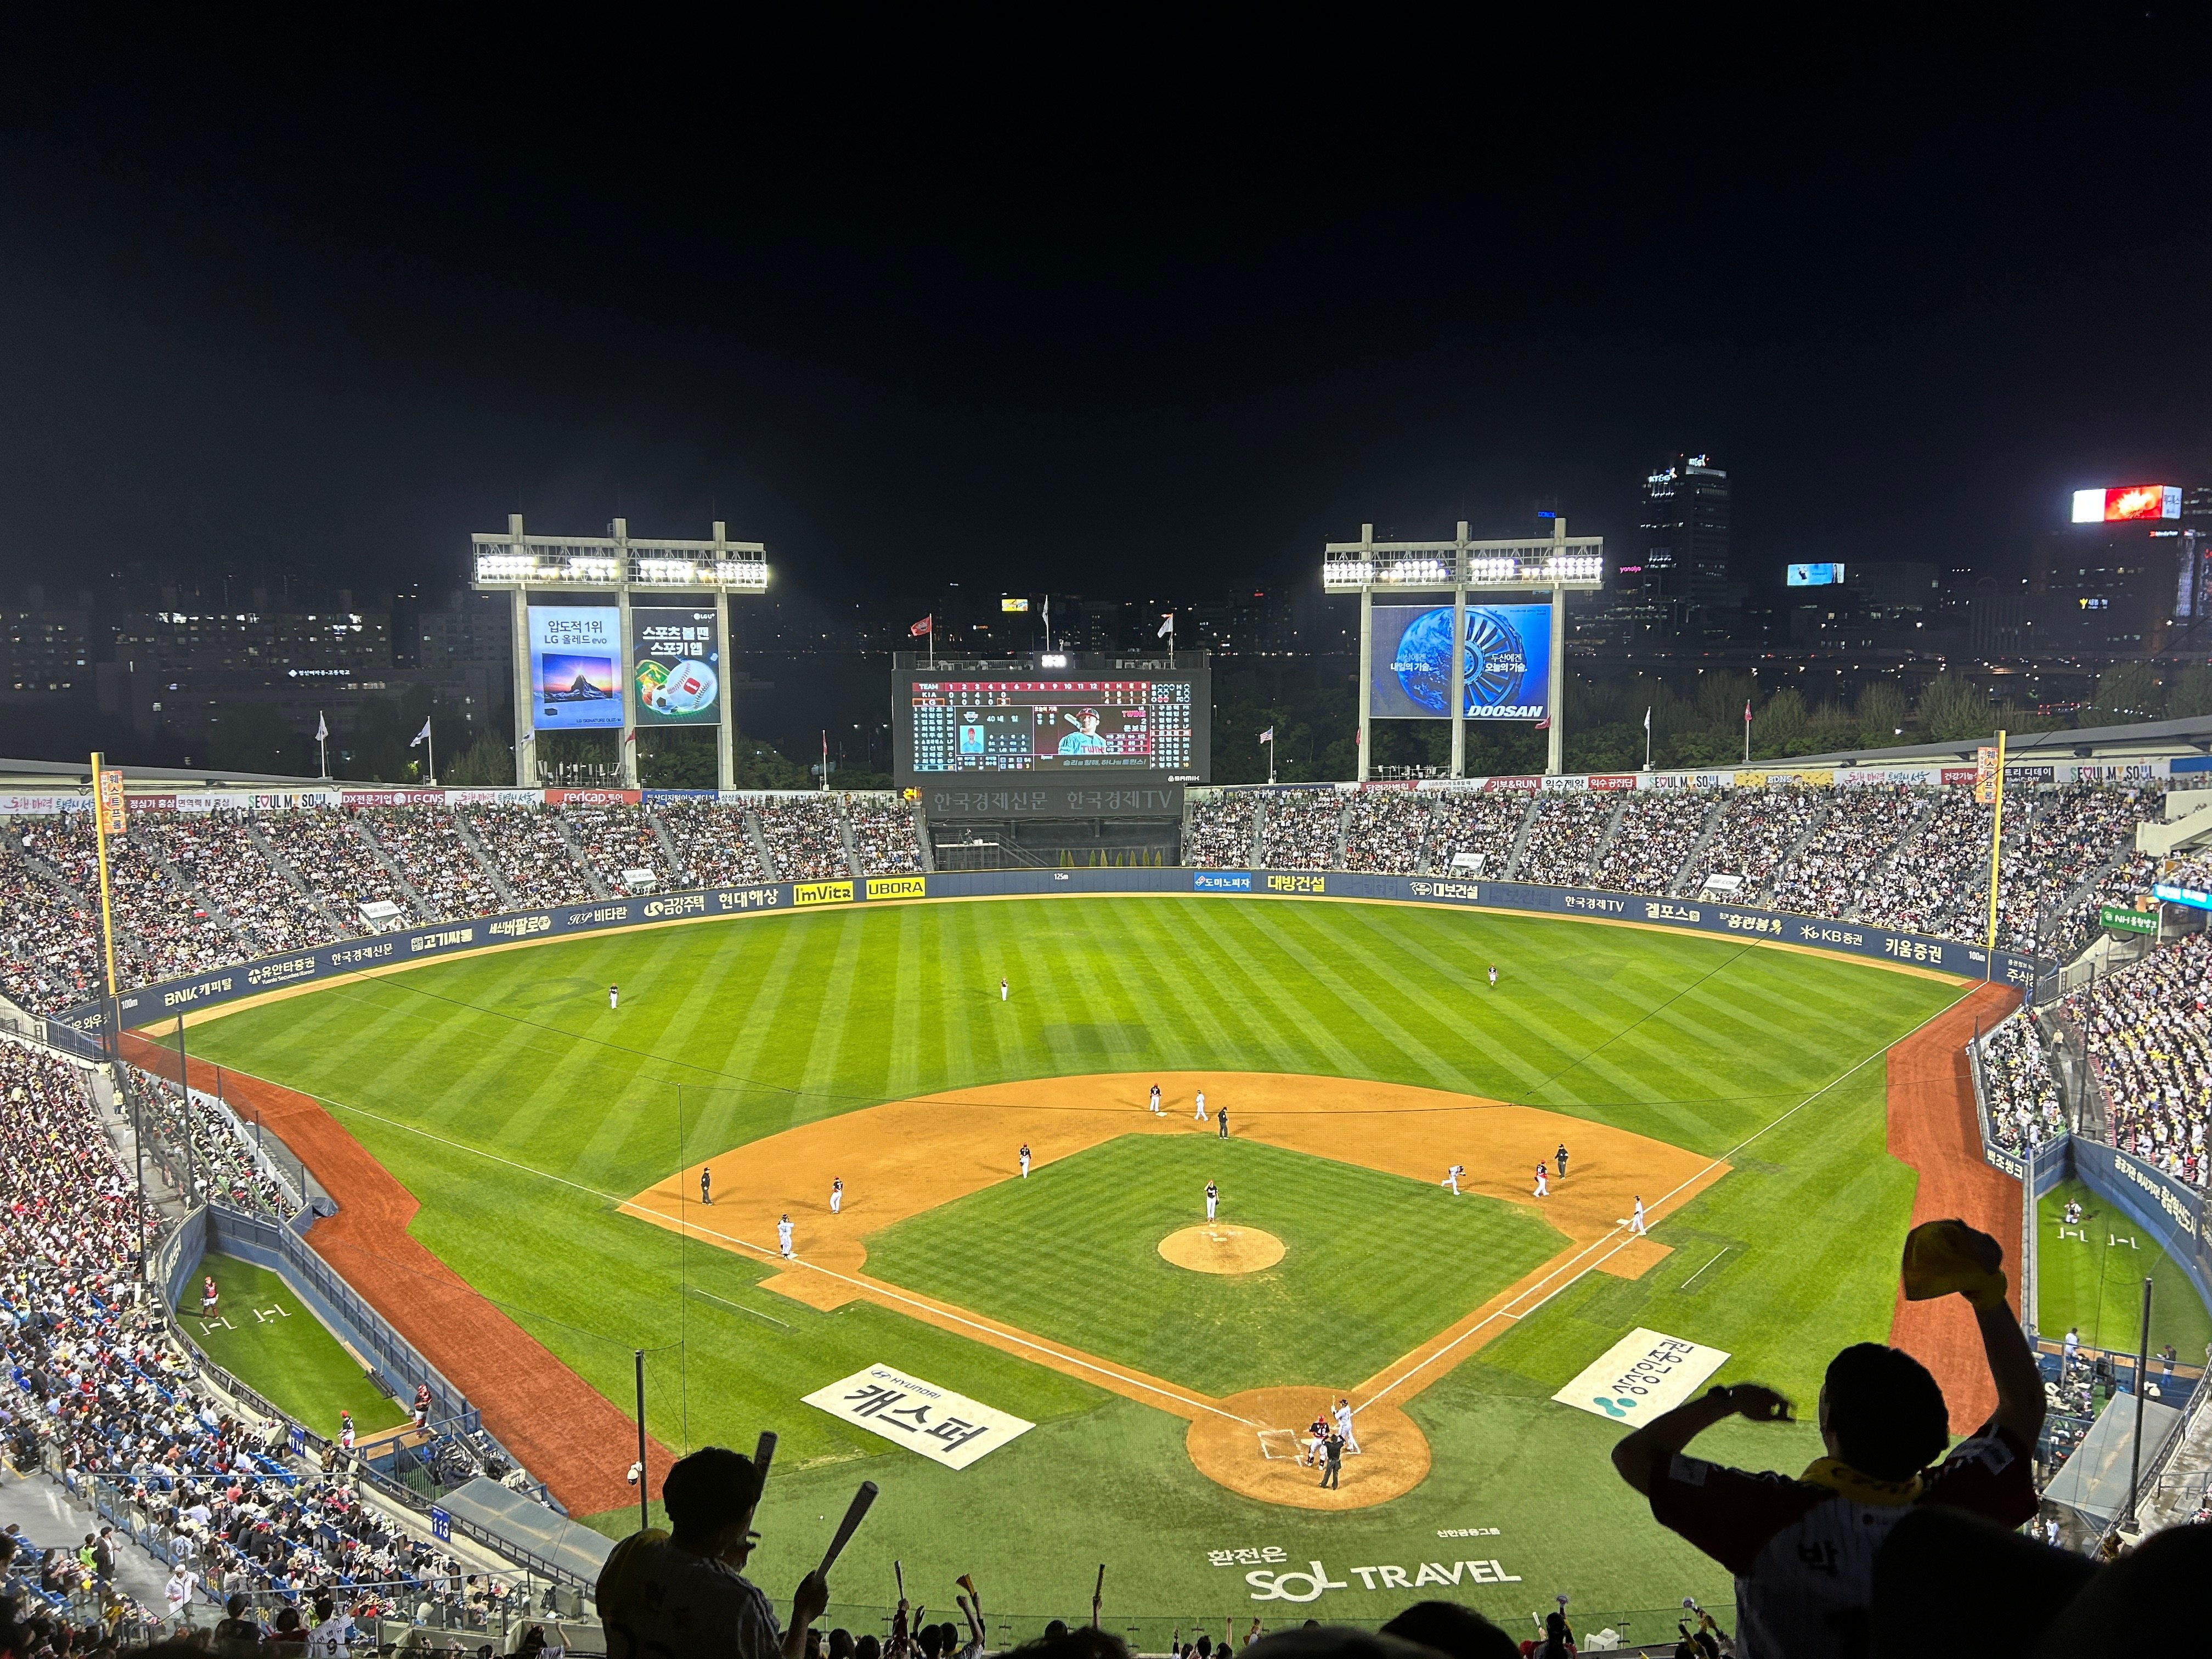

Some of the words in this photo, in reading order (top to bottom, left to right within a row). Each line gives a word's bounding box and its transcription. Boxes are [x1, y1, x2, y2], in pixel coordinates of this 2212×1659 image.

[1620, 566, 1641, 574] yanolja
[548, 620, 582, 633] 압도적
[585, 620, 602, 633] 1위
[642, 626, 681, 641] 스포츠
[544, 636, 558, 645] LG
[561, 634, 591, 645] 올레드
[651, 642, 688, 656] 스포키
[690, 642, 703, 656] 앱
[1468, 706, 1543, 717] DOOSAN
[1545, 779, 1584, 788] 익수제약
[1591, 778, 1607, 787] 익수
[1608, 778, 1634, 788] 공진단
[1767, 775, 1792, 784] BDNS
[1911, 771, 1930, 782] 서울
[1491, 780, 1536, 789] 기부&RUN
[129, 799, 156, 809] 정심가
[158, 799, 174, 808] 홍삼
[177, 798, 202, 806] 면역력
[343, 794, 392, 804] DX전문기업
[408, 794, 421, 804] LG
[422, 794, 444, 804] CNS
[518, 792, 535, 804] 서울
[564, 792, 606, 804] redcap
[934, 792, 1046, 811] 한국경제신문
[1067, 791, 1172, 809] 한국경제TV
[869, 882, 923, 895] UBORA
[1205, 877, 1250, 888] 도미노피자
[1268, 875, 1325, 892] 대방건설
[719, 888, 778, 909] 현대해상
[1433, 883, 1478, 899] 대보건설
[664, 895, 704, 916] 금강주택
[1565, 895, 1624, 912] 한국경제TV
[594, 906, 627, 922] 비타란
[1645, 902, 1689, 921] 겔포스
[2114, 915, 2130, 924] NH
[331, 943, 393, 966] 한국경제신문
[1886, 938, 1942, 964] 키움증권
[1968, 950, 1985, 962] 100m
[262, 957, 315, 978] 유안타증권
[165, 987, 198, 1007] BNK
[199, 977, 233, 996] 캐피탈
[121, 999, 138, 1009] 100m
[1987, 1148, 2023, 1180] 백조씽크
[1612, 1339, 1694, 1395] 상상인증권
[890, 1376, 941, 1399] HYUNDAI
[844, 1384, 990, 1453] 캐스퍼
[433, 1517, 448, 1538] 113
[1207, 1546, 1287, 1567] 환전은
[206, 1576, 218, 1592] 113
[1245, 1561, 1347, 1602] SOL
[1350, 1560, 1522, 1590] TRAVEL
[327, 1638, 337, 1656] 9
